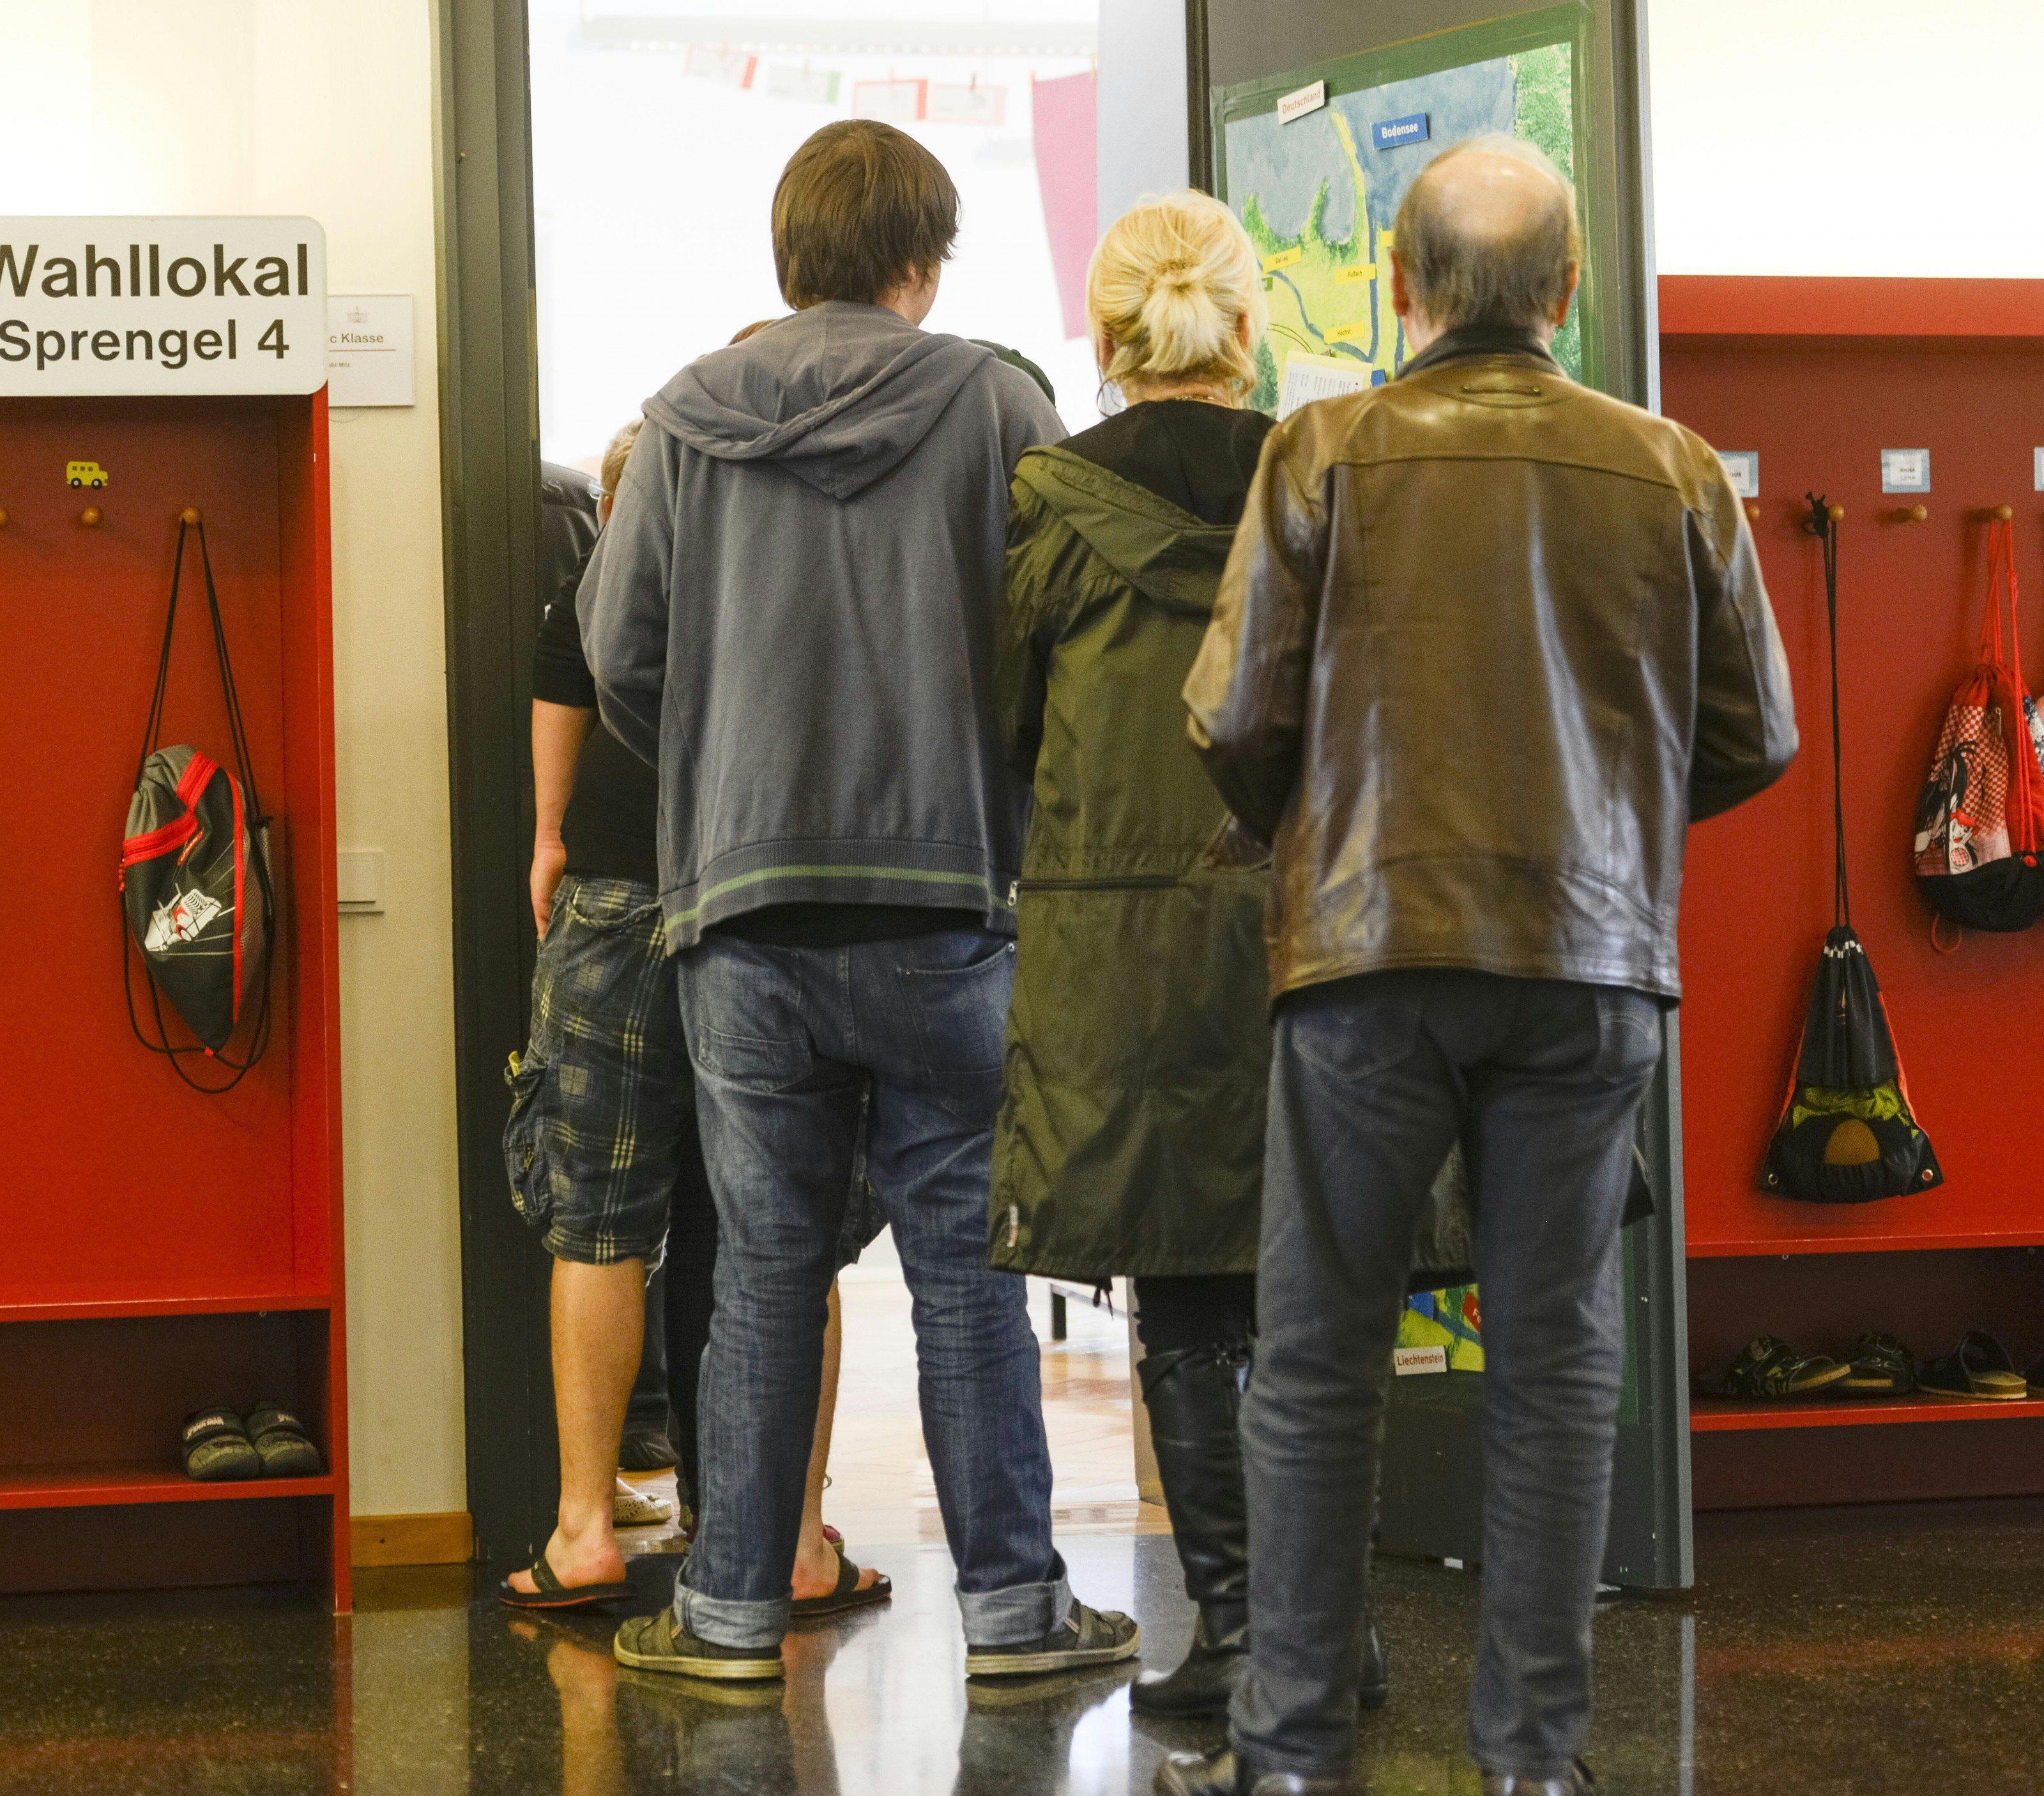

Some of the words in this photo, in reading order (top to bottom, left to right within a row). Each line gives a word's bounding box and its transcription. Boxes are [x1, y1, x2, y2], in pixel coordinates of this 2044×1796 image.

[1282, 89, 1321, 114] Deutschland
[1382, 123, 1419, 139] Bodensee
[0, 243, 309, 298] Wahllokal
[0, 319, 237, 371] Sprengel
[257, 319, 289, 359] 4
[341, 333, 384, 344] Klasse
[1397, 1353, 1444, 1367] Liechtenstein
